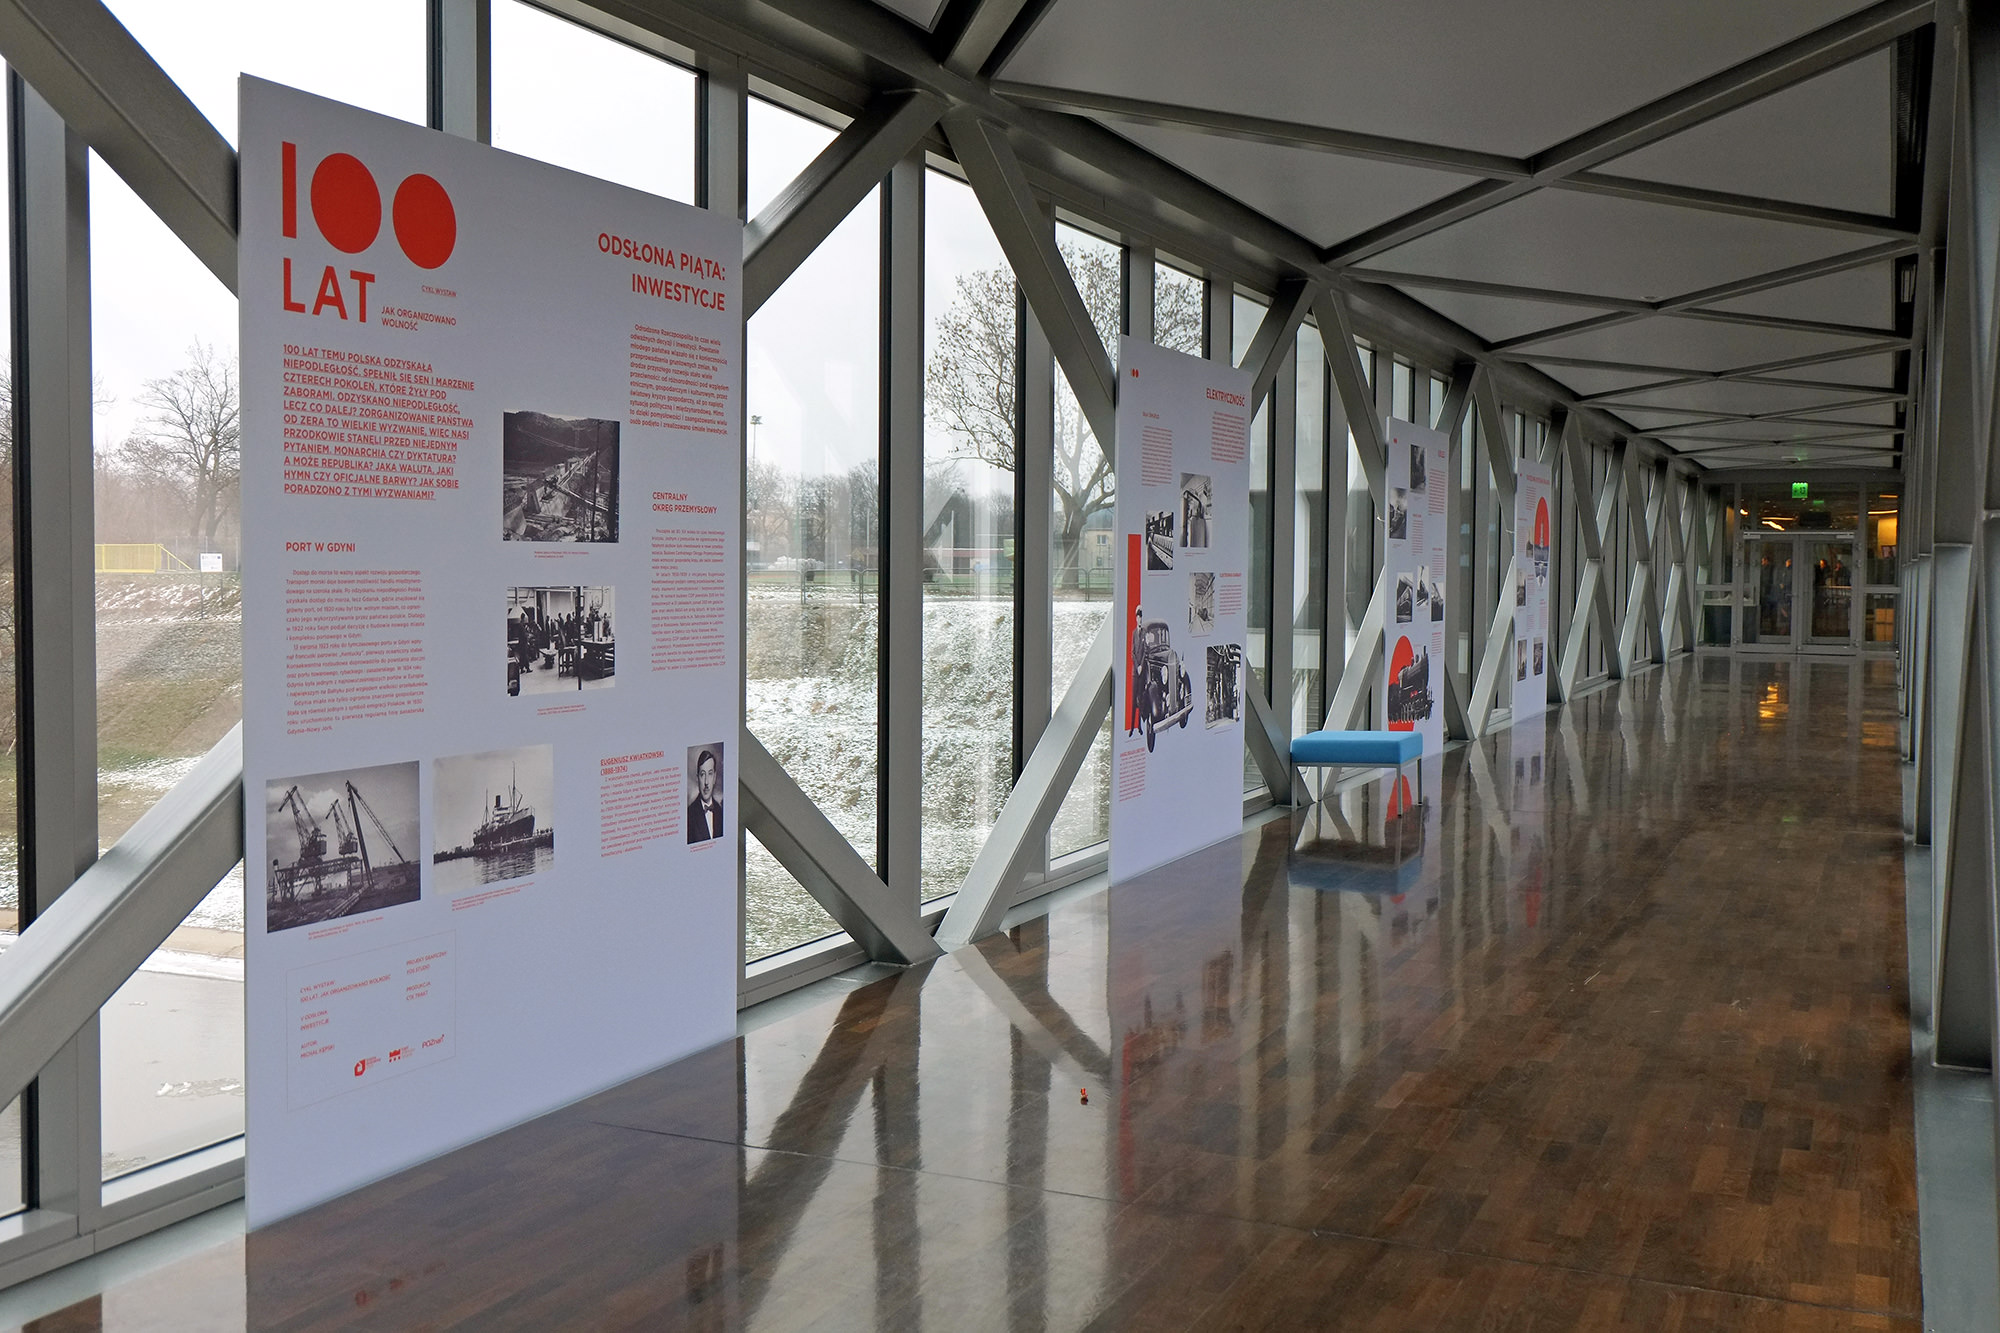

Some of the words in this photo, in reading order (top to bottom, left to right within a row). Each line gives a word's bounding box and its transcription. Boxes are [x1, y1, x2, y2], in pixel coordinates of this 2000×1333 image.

[282, 141, 456, 269] 100
[598, 233, 675, 269] ODSŁONA
[680, 253, 726, 281] PIĄTA:
[283, 257, 375, 323] LAT
[632, 274, 725, 311] INWESTYCJE
[381, 306, 395, 316] JAK
[397, 308, 456, 326] ORGANIZOWANO
[382, 318, 419, 331] WOLNOŚĆ
[284, 344, 300, 356] 100
[302, 347, 318, 358] LAT
[321, 349, 346, 362] TEMU
[348, 353, 381, 366] POLSKA
[384, 357, 432, 372] ODZYSKAŁA
[283, 373, 332, 387] CZTERECH
[379, 382, 406, 395] KTÓRE
[409, 386, 428, 397] ŻYŁY
[430, 389, 446, 399] POD
[364, 368, 396, 381] SPEŁNIŁ
[400, 373, 412, 384] SIĘ
[414, 374, 429, 385] SEN
[436, 377, 474, 390] MARZENIE
[338, 392, 391, 406] ODZYSKANO
[284, 400, 307, 412] LECZ
[310, 403, 323, 413] CO
[325, 404, 357, 416] DALEJ?
[360, 408, 435, 423] ZORGANIZOWANIE
[437, 414, 473, 427] PAŃSTWA
[284, 414, 298, 424] OD
[301, 416, 324, 427] ZERA
[328, 418, 339, 428] TO
[342, 420, 376, 431] WIELKIE
[430, 427, 449, 439] WIĘC
[452, 429, 468, 439] NASI
[284, 428, 344, 442] PRZODKOWIE
[348, 433, 381, 446] STANĘLI
[384, 436, 410, 446] PRZED
[413, 439, 457, 450] NIEJEDNYM
[334, 446, 386, 458] MONARCHIA
[389, 450, 404, 459] CZY
[407, 451, 456, 463] DYKTATURA?
[284, 456, 291, 465] A
[293, 456, 319, 467] MOŻE
[321, 459, 373, 470] REPUBLIKA?
[375, 462, 397, 472] JAKA
[436, 467, 454, 476] JAKI
[284, 470, 311, 480] HYMN
[314, 472, 330, 482] CZY
[334, 473, 380, 484] OFICJALNE
[383, 476, 417, 486] BARWY?
[419, 478, 434, 487] JAK
[436, 479, 459, 488] SOBIE
[284, 484, 342, 495] PORADZONO
[345, 487, 350, 495] Z
[353, 487, 372, 496] TYMI
[375, 488, 434, 498] WYZWANIAMI?
[652, 492, 688, 501] CENTRALNY
[652, 503, 673, 513] OKRĘG
[674, 505, 717, 514] PRZEMYSŁOWY
[286, 542, 312, 552] PORT
[315, 542, 324, 552] W
[327, 543, 356, 552] GDYNI
